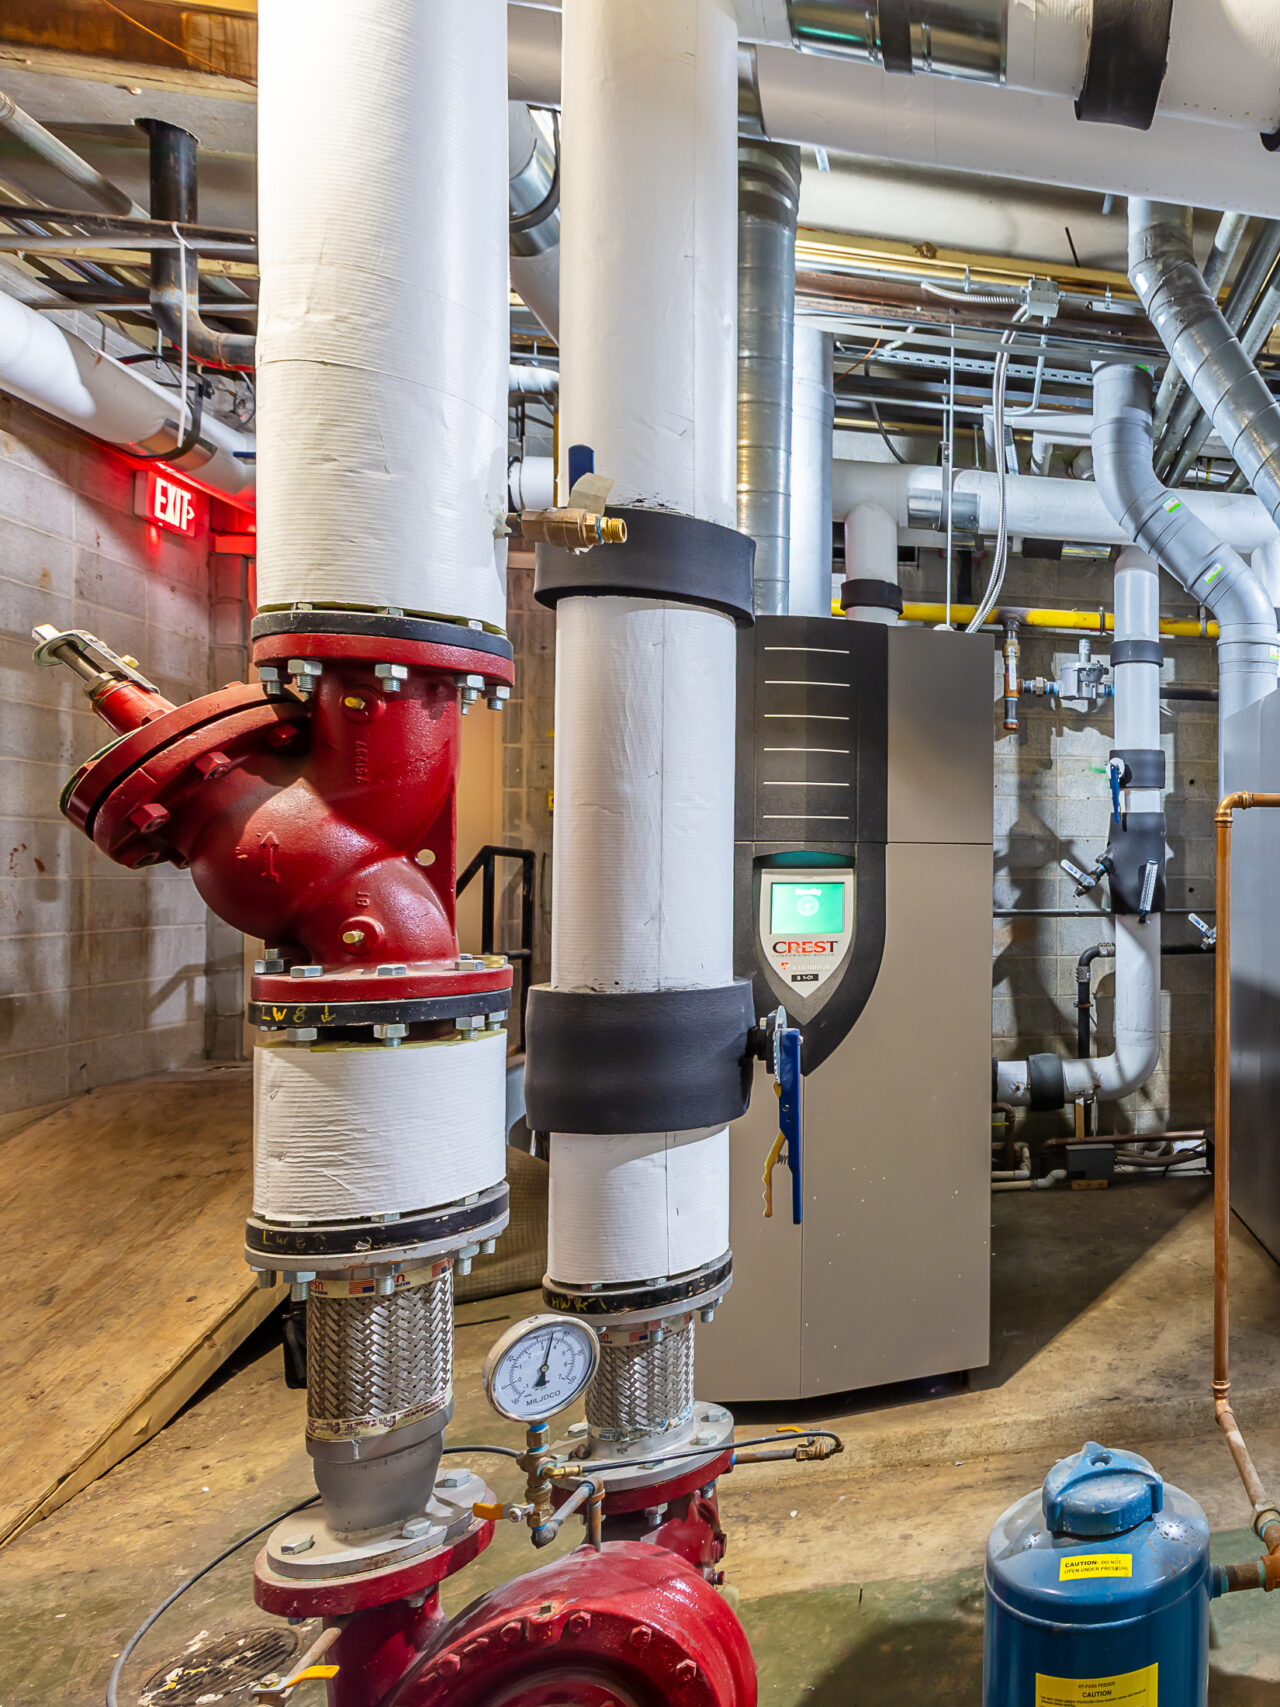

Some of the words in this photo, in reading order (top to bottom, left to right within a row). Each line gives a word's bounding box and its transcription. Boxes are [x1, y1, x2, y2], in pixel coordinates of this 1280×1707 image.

[154, 477, 192, 531] EXIT
[772, 940, 838, 954] CREST
[526, 1390, 561, 1407] MILJOCO
[1081, 1689, 1112, 1698] CAUTION
